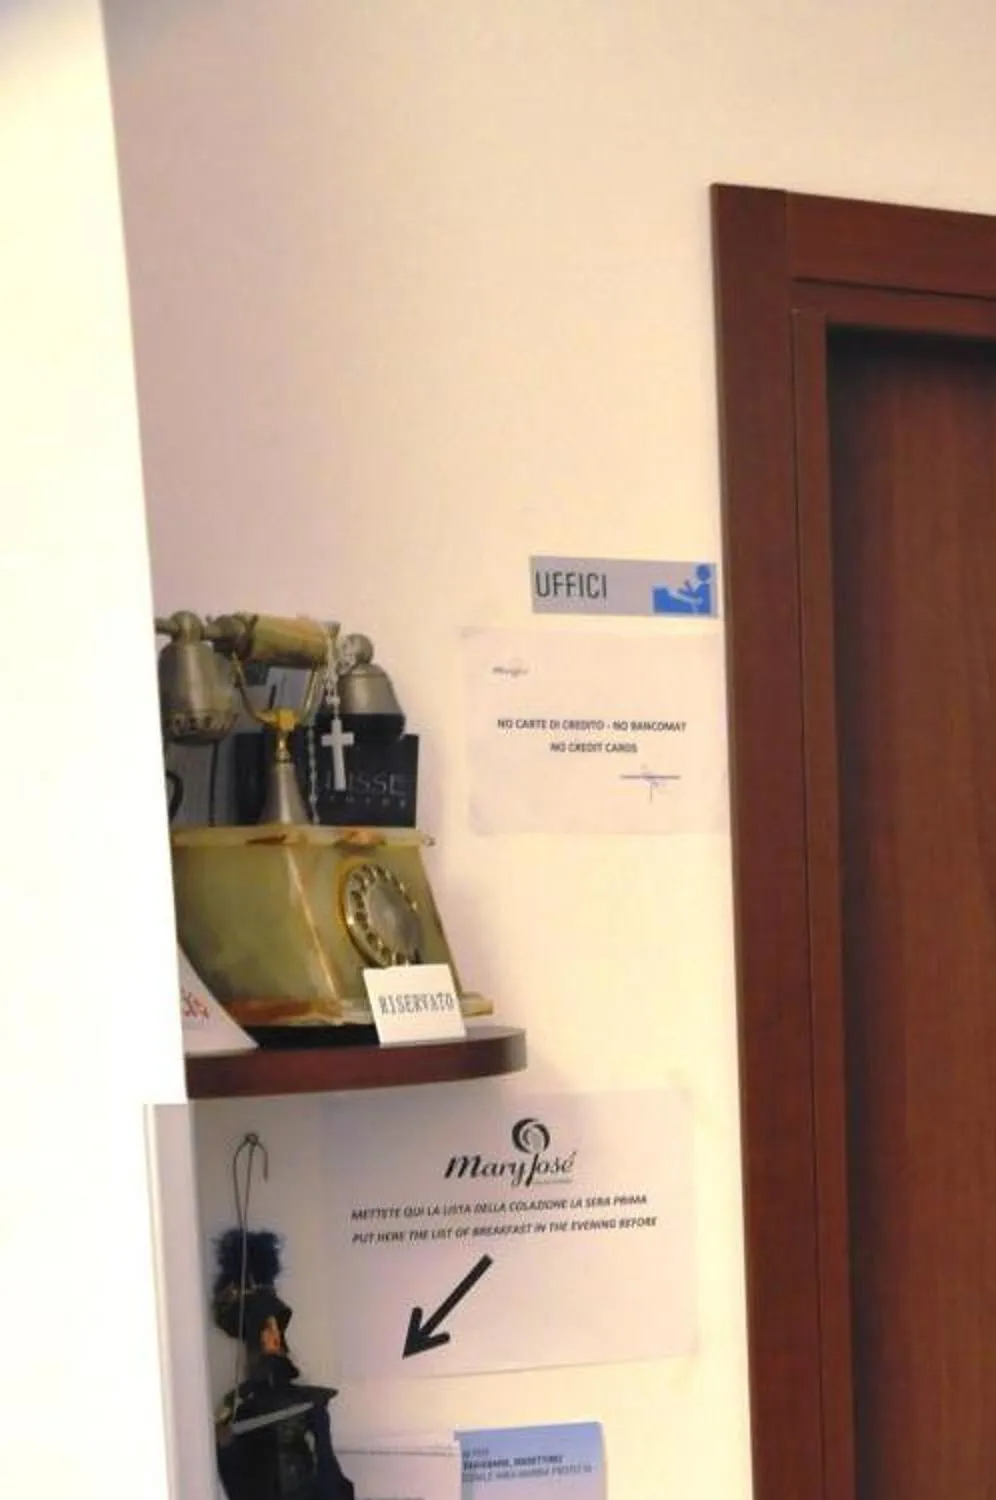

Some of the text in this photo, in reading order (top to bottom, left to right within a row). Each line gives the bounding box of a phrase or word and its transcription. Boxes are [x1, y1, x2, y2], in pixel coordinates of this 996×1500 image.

[535, 571, 607, 599] UFFICI
[497, 719, 513, 730] NO
[515, 719, 546, 730] CARTE
[549, 720, 560, 730] DI
[562, 719, 604, 731] CREDITO
[612, 721, 629, 731] NO
[631, 721, 687, 732] BANCOMAT
[550, 742, 638, 754] NO CREDIT CARDS
[378, 991, 455, 1015] RISERVATO
[351, 1195, 647, 1219] METTETE QUI LA LISTA DELLA COLAZIONE LA SERA PRIMA
[351, 1216, 658, 1243] PUT HERE THE LIST OF BREAKFAST IN THE EVENING BEFORE
